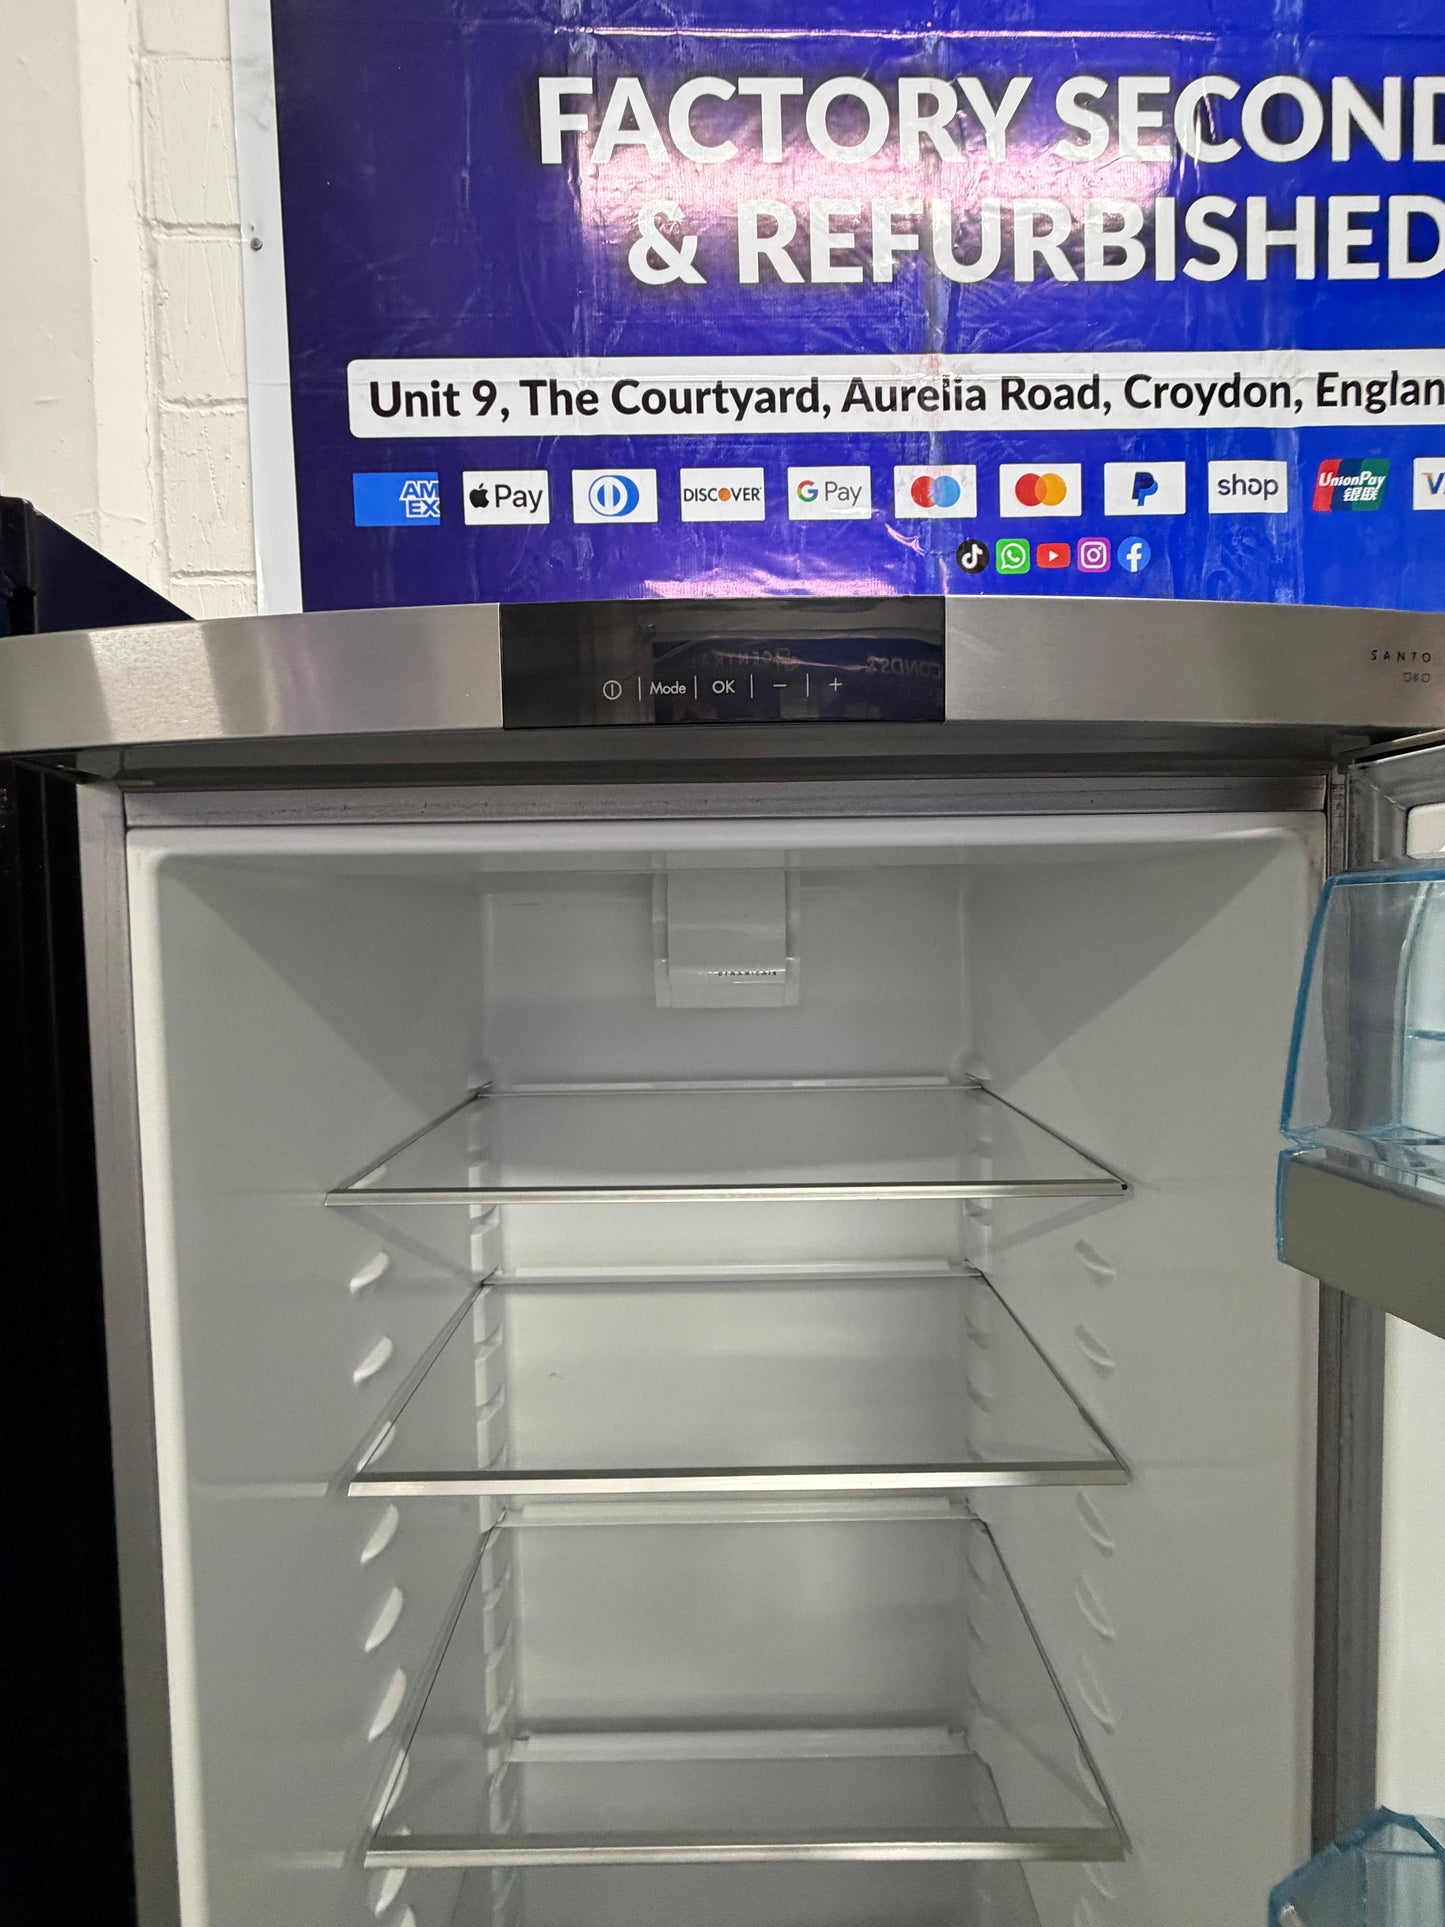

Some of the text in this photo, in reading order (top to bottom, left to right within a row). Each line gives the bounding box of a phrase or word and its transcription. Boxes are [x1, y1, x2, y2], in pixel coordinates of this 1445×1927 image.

[538, 75, 1034, 166] FACTORY
[627, 194, 1445, 286] & REFURBISHED
[369, 369, 1445, 423] Unit 9, The Courtyard, Aurelia Road, Croydon, Englan
[1217, 473, 1279, 501] shop
[1318, 470, 1386, 490] UnionPay
[495, 484, 543, 513] Pay
[683, 487, 761, 502] DISCOVER
[825, 481, 862, 506] Pay
[1343, 487, 1379, 501] 银联
[1370, 649, 1431, 662] SANTO
[650, 681, 687, 696] Mode
[712, 680, 735, 694] OK
